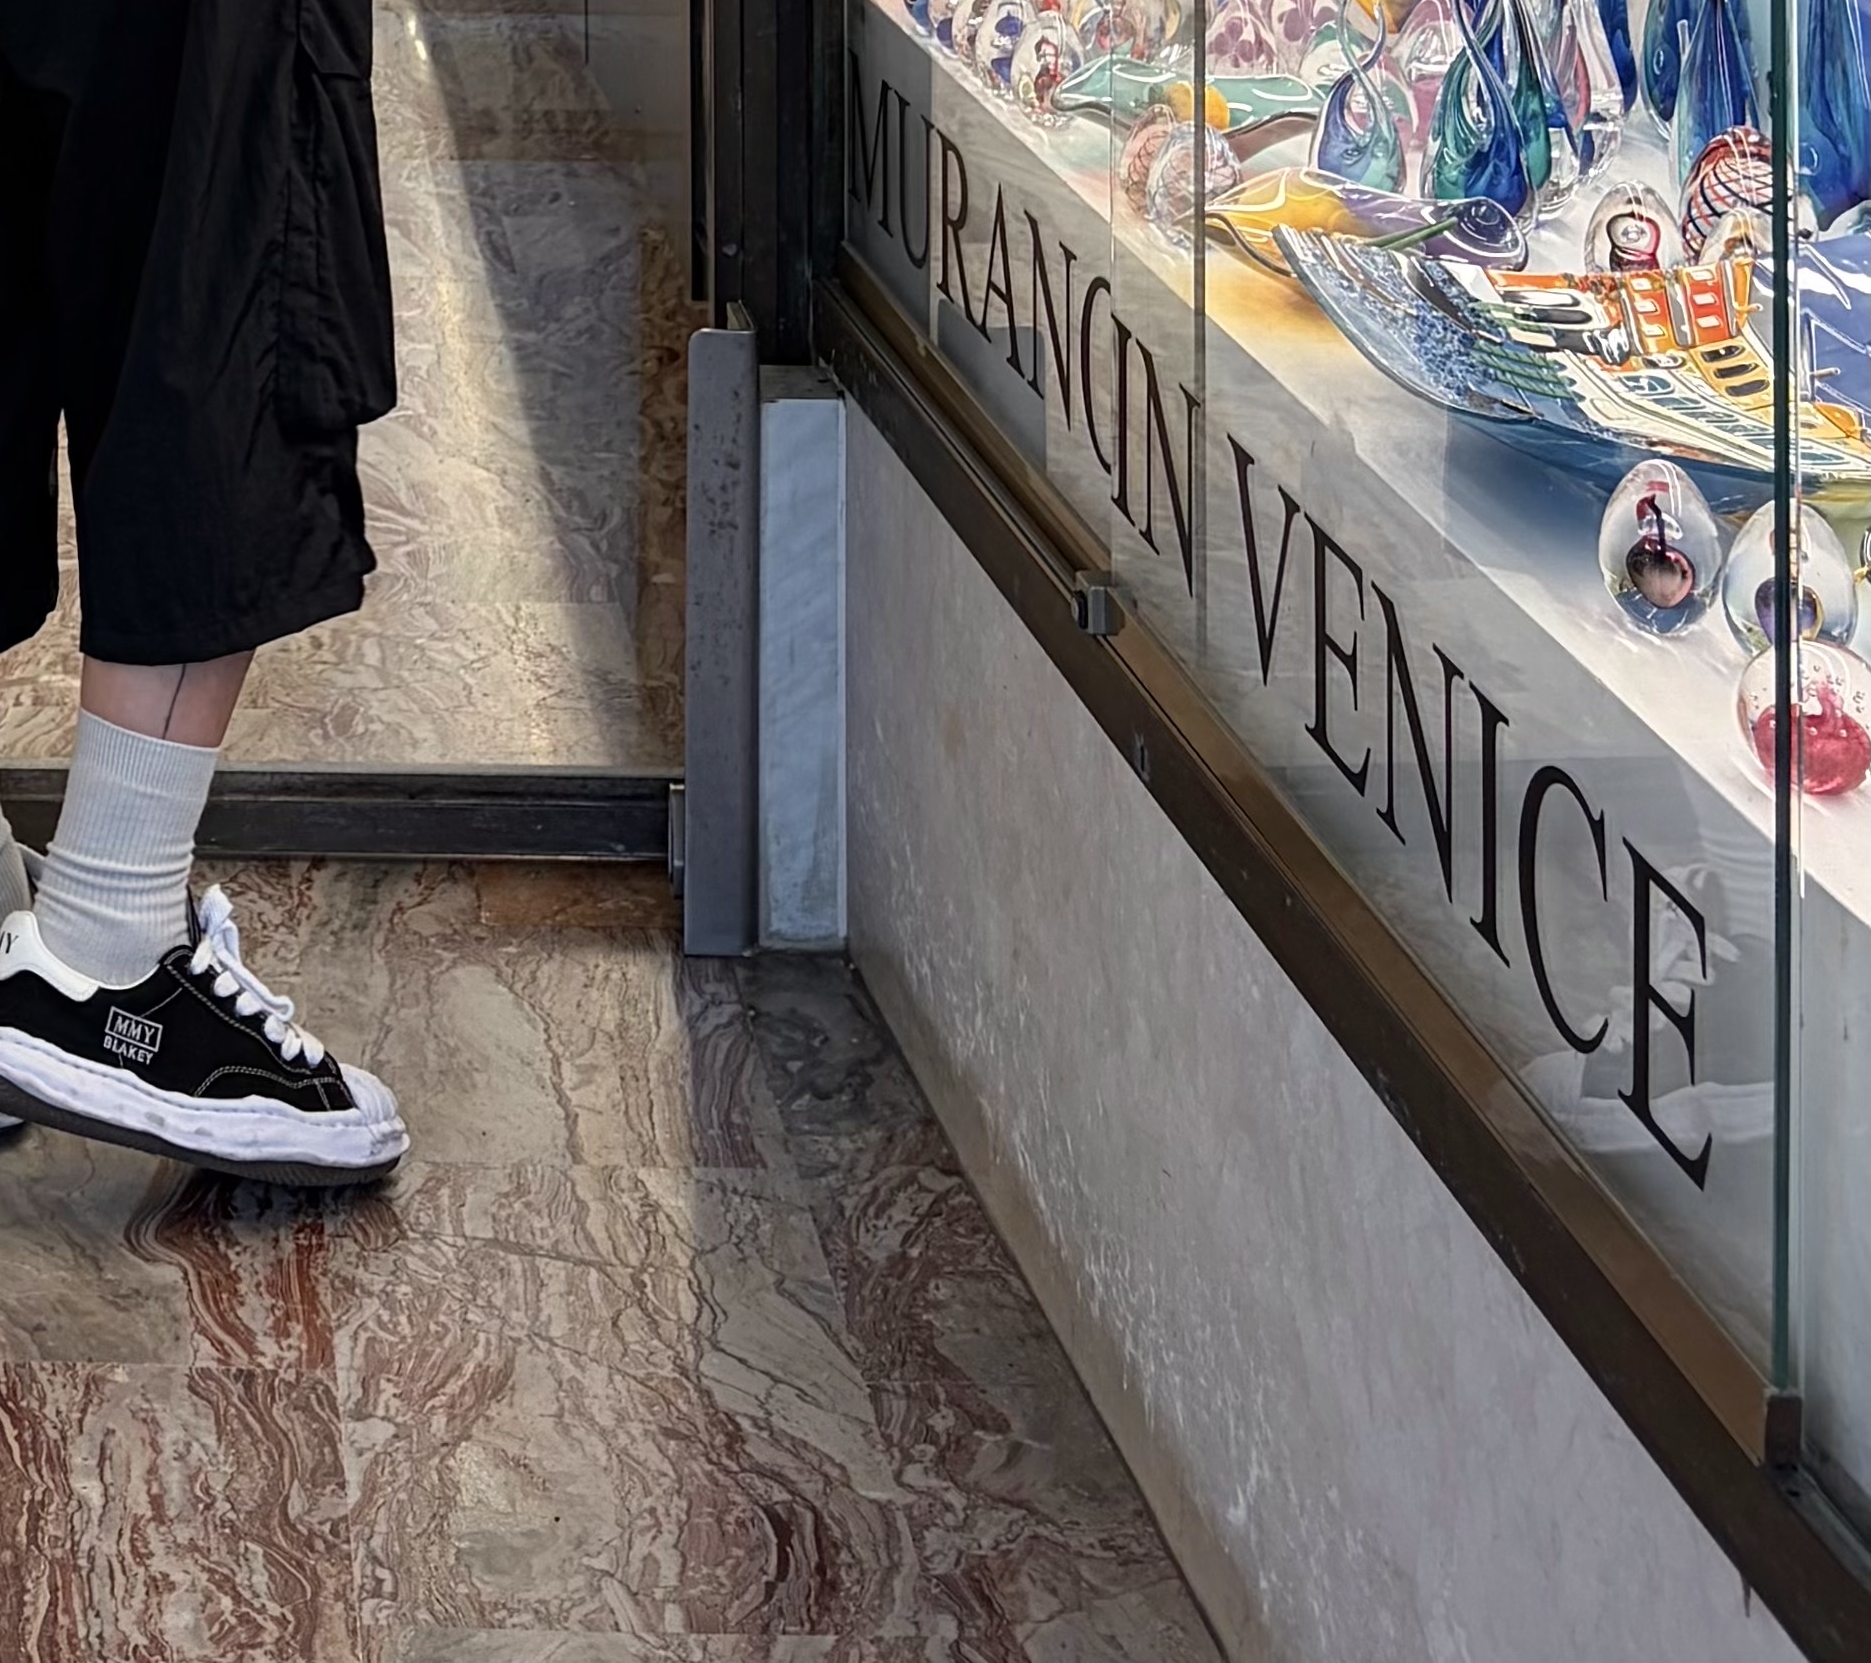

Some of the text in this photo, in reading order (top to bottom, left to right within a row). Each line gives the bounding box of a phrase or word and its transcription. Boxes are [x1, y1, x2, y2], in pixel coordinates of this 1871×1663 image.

[1111, 311, 1202, 598] IN
[1227, 432, 1713, 1191] VENICE
[113, 1015, 156, 1045] MMY
[103, 1035, 154, 1066] BLAKEY
